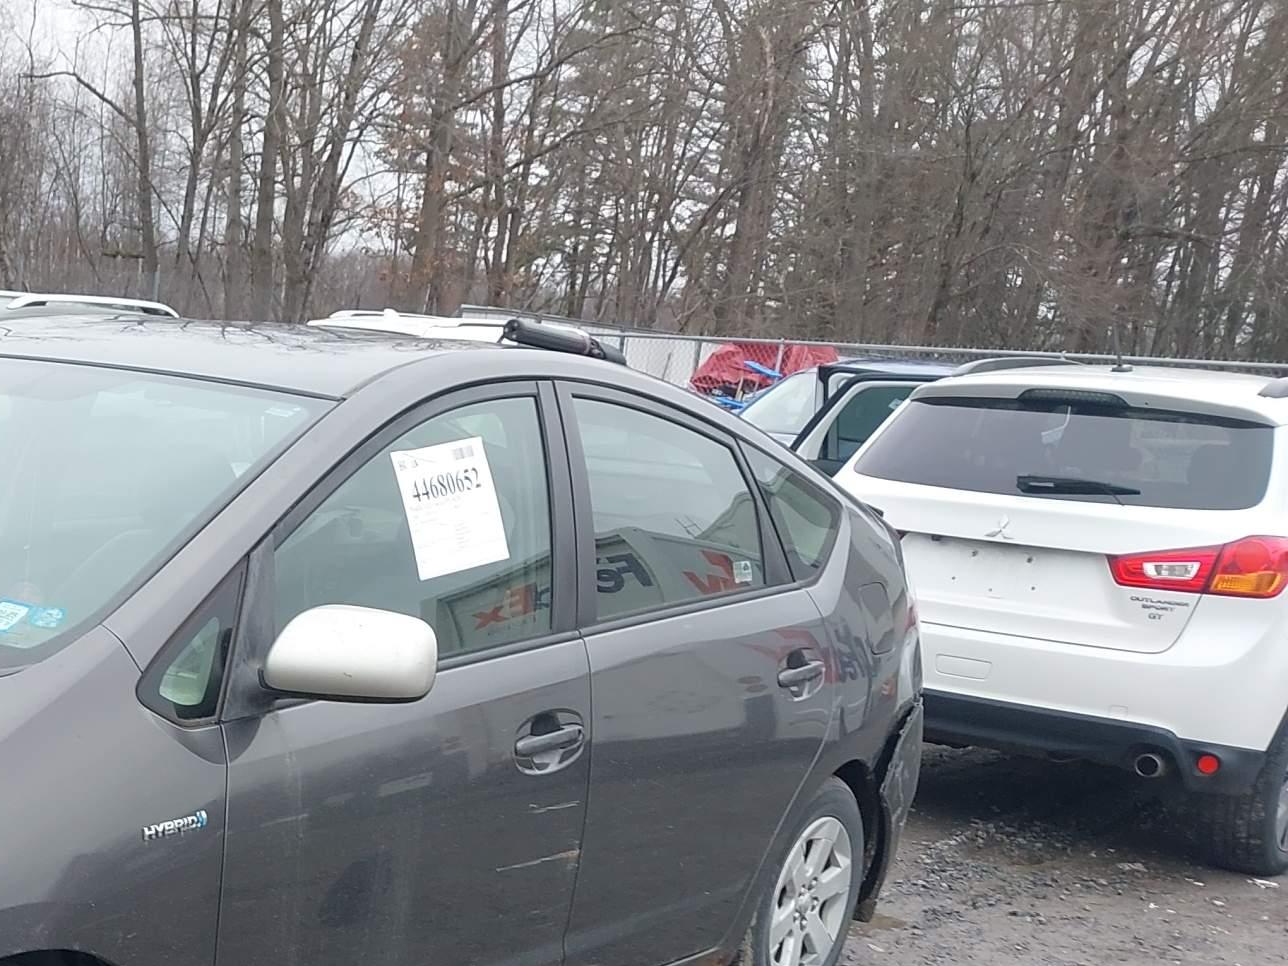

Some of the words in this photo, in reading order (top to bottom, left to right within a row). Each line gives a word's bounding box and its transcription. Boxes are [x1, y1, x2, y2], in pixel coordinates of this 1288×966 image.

[412, 467, 481, 502] 44680652
[1148, 612, 1163, 620] GT
[142, 815, 199, 841] HYBRID
